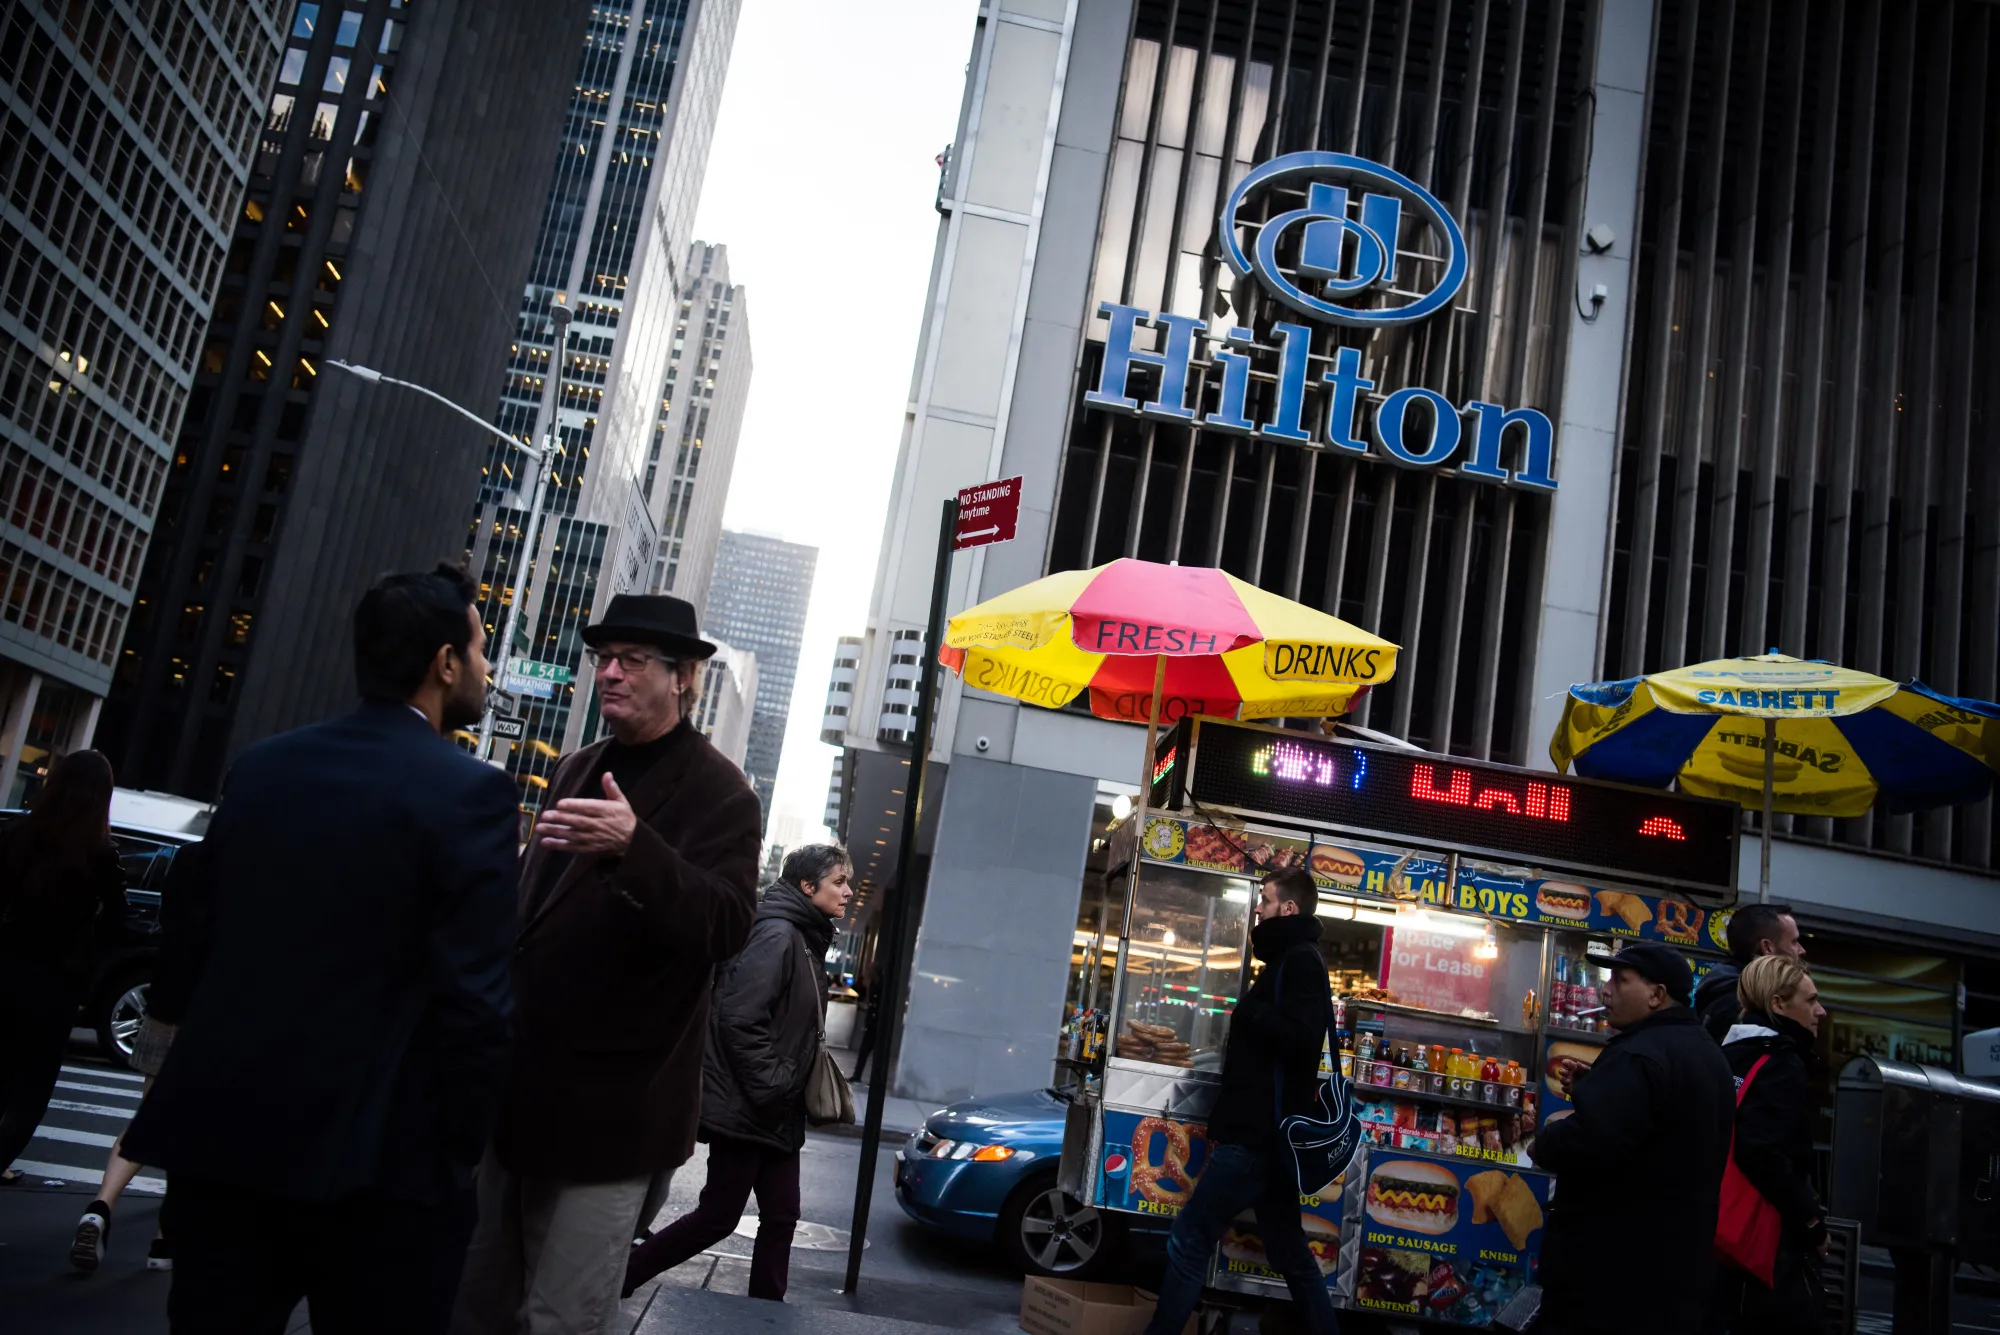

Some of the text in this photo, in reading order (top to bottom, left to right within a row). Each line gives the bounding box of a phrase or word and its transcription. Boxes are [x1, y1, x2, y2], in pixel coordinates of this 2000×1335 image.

[1085, 301, 1559, 490] Hilton
[960, 484, 1011, 506] NO STANDING
[958, 506, 990, 521] Anytime
[1012, 629, 1034, 641] STEEL
[1096, 620, 1217, 653] FRESH
[1274, 644, 1381, 680] DRINKS
[522, 661, 567, 680] W 54 ST
[509, 676, 552, 692] MARATHON
[1697, 688, 1840, 710] SABRETT
[497, 721, 518, 733] WAY
[1143, 818, 1184, 843] HALAL BOYS
[1148, 848, 1175, 859] NEW YORK
[1187, 859, 1216, 871] CHICKEN
[1313, 877, 1334, 887] HOT
[1366, 870, 1529, 917] HLAL BOYS
[1539, 914, 1590, 929] HOT SAUSAGE
[1610, 926, 1640, 937] KNISH
[1663, 935, 1698, 946] PRETZEL
[1390, 946, 1484, 978] for Lease
[1361, 1121, 1372, 1129] ater
[1399, 1126, 1420, 1136] Gatorade
[1455, 1145, 1518, 1164] BEEF KEBAB
[1137, 1199, 1183, 1217] PRET
[1299, 1193, 1320, 1207] OG
[1367, 1232, 1458, 1255] HOT SAUSAGE
[1479, 1250, 1518, 1263] KNISH
[1228, 1260, 1257, 1275] HOT
[1360, 1297, 1417, 1314] CHASTENTS
